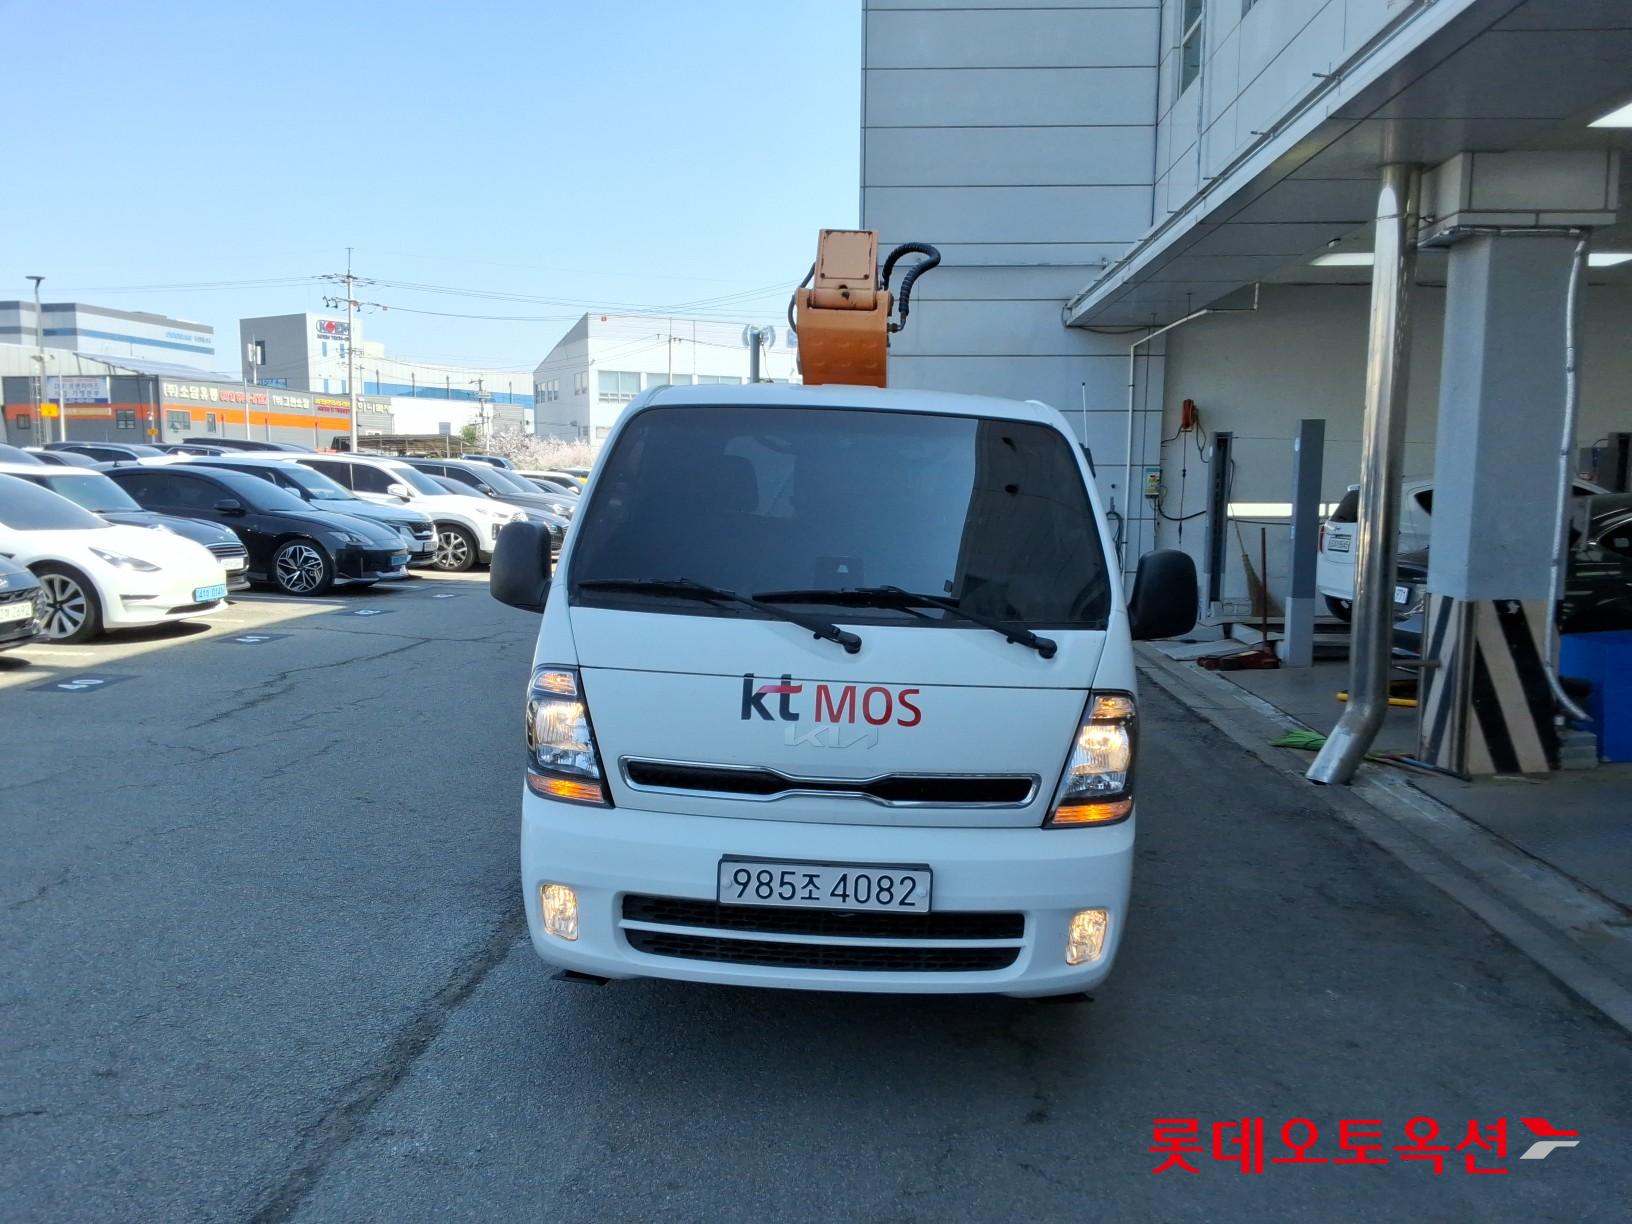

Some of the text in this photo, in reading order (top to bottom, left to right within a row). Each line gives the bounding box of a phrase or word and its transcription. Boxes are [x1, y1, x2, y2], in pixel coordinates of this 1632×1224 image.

[57, 679, 105, 690] 40
[741, 673, 922, 728] kt MOS
[733, 868, 917, 907] 985조 4082
